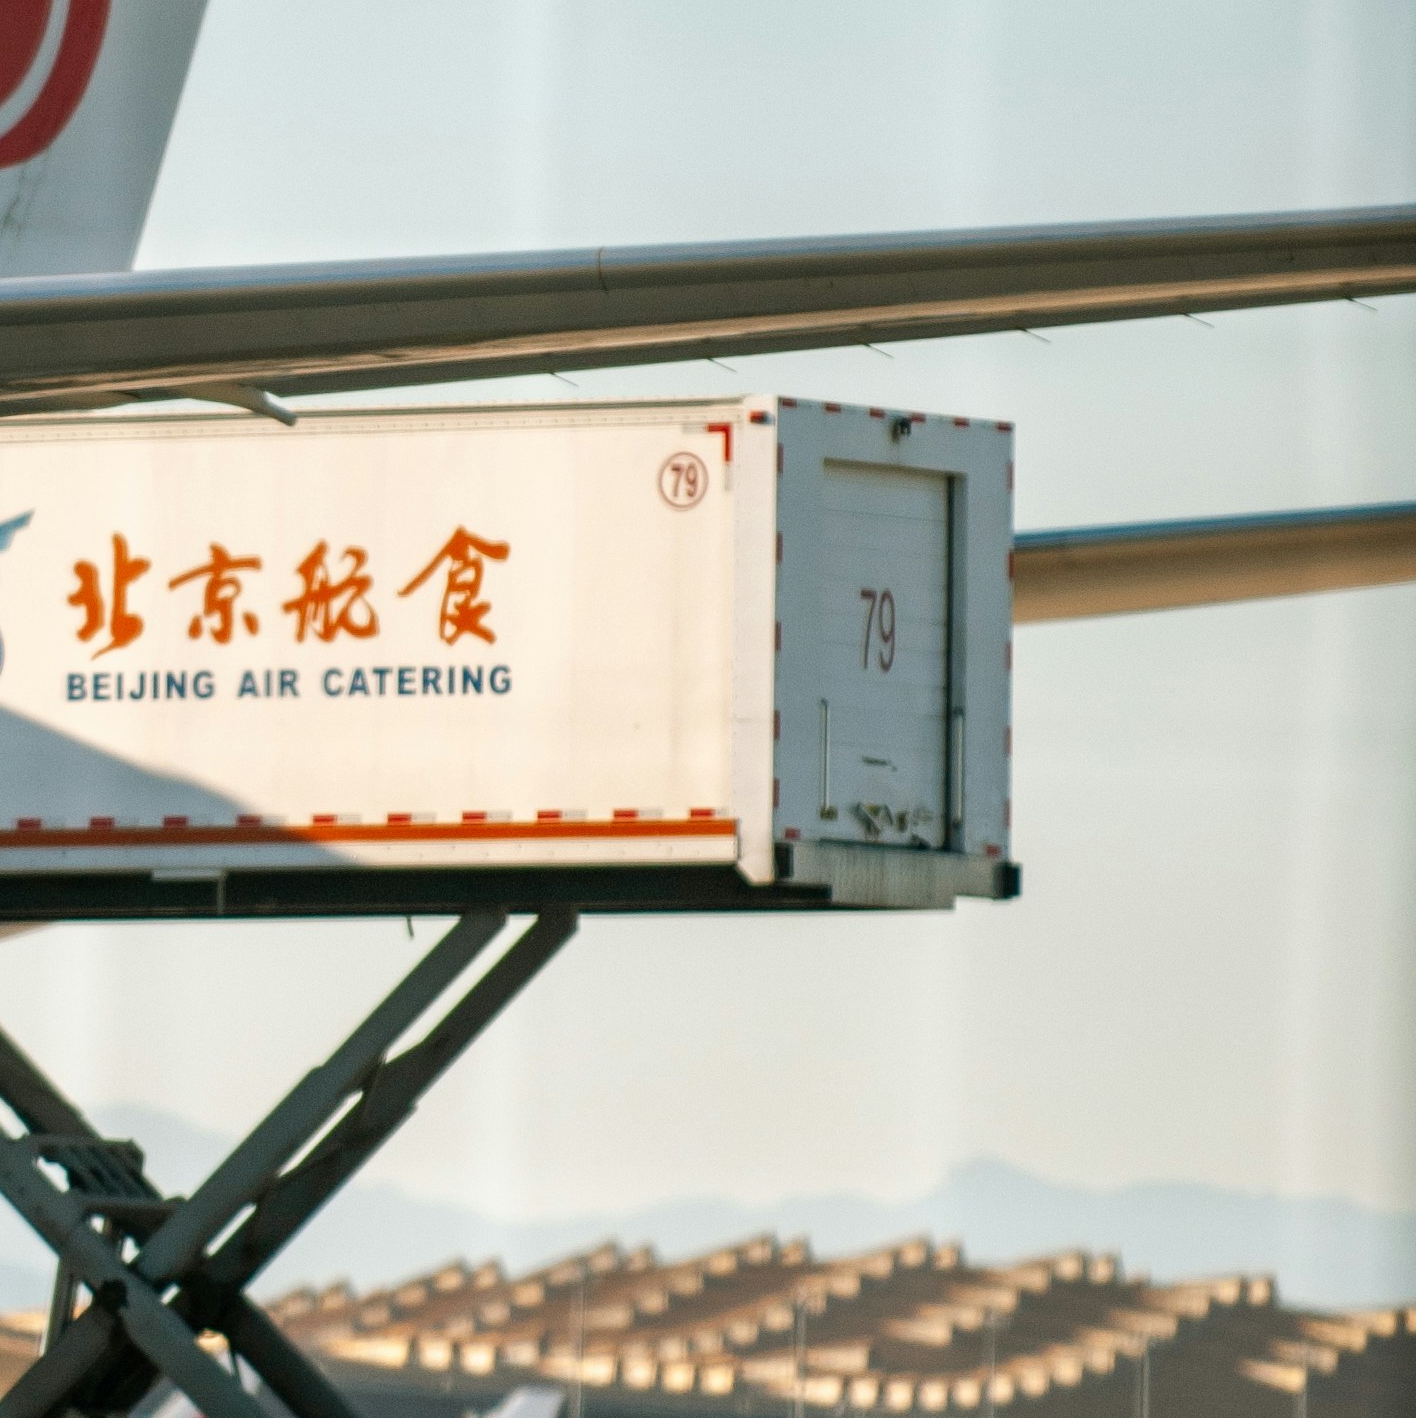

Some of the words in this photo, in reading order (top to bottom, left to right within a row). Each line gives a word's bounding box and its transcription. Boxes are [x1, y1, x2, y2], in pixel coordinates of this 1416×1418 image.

[670, 462, 699, 499] 79
[66, 525, 511, 661] 北京航食
[859, 586, 897, 674] 79
[66, 670, 216, 702] BEIJING
[237, 668, 302, 699] AIR
[322, 663, 513, 698] CATERING
